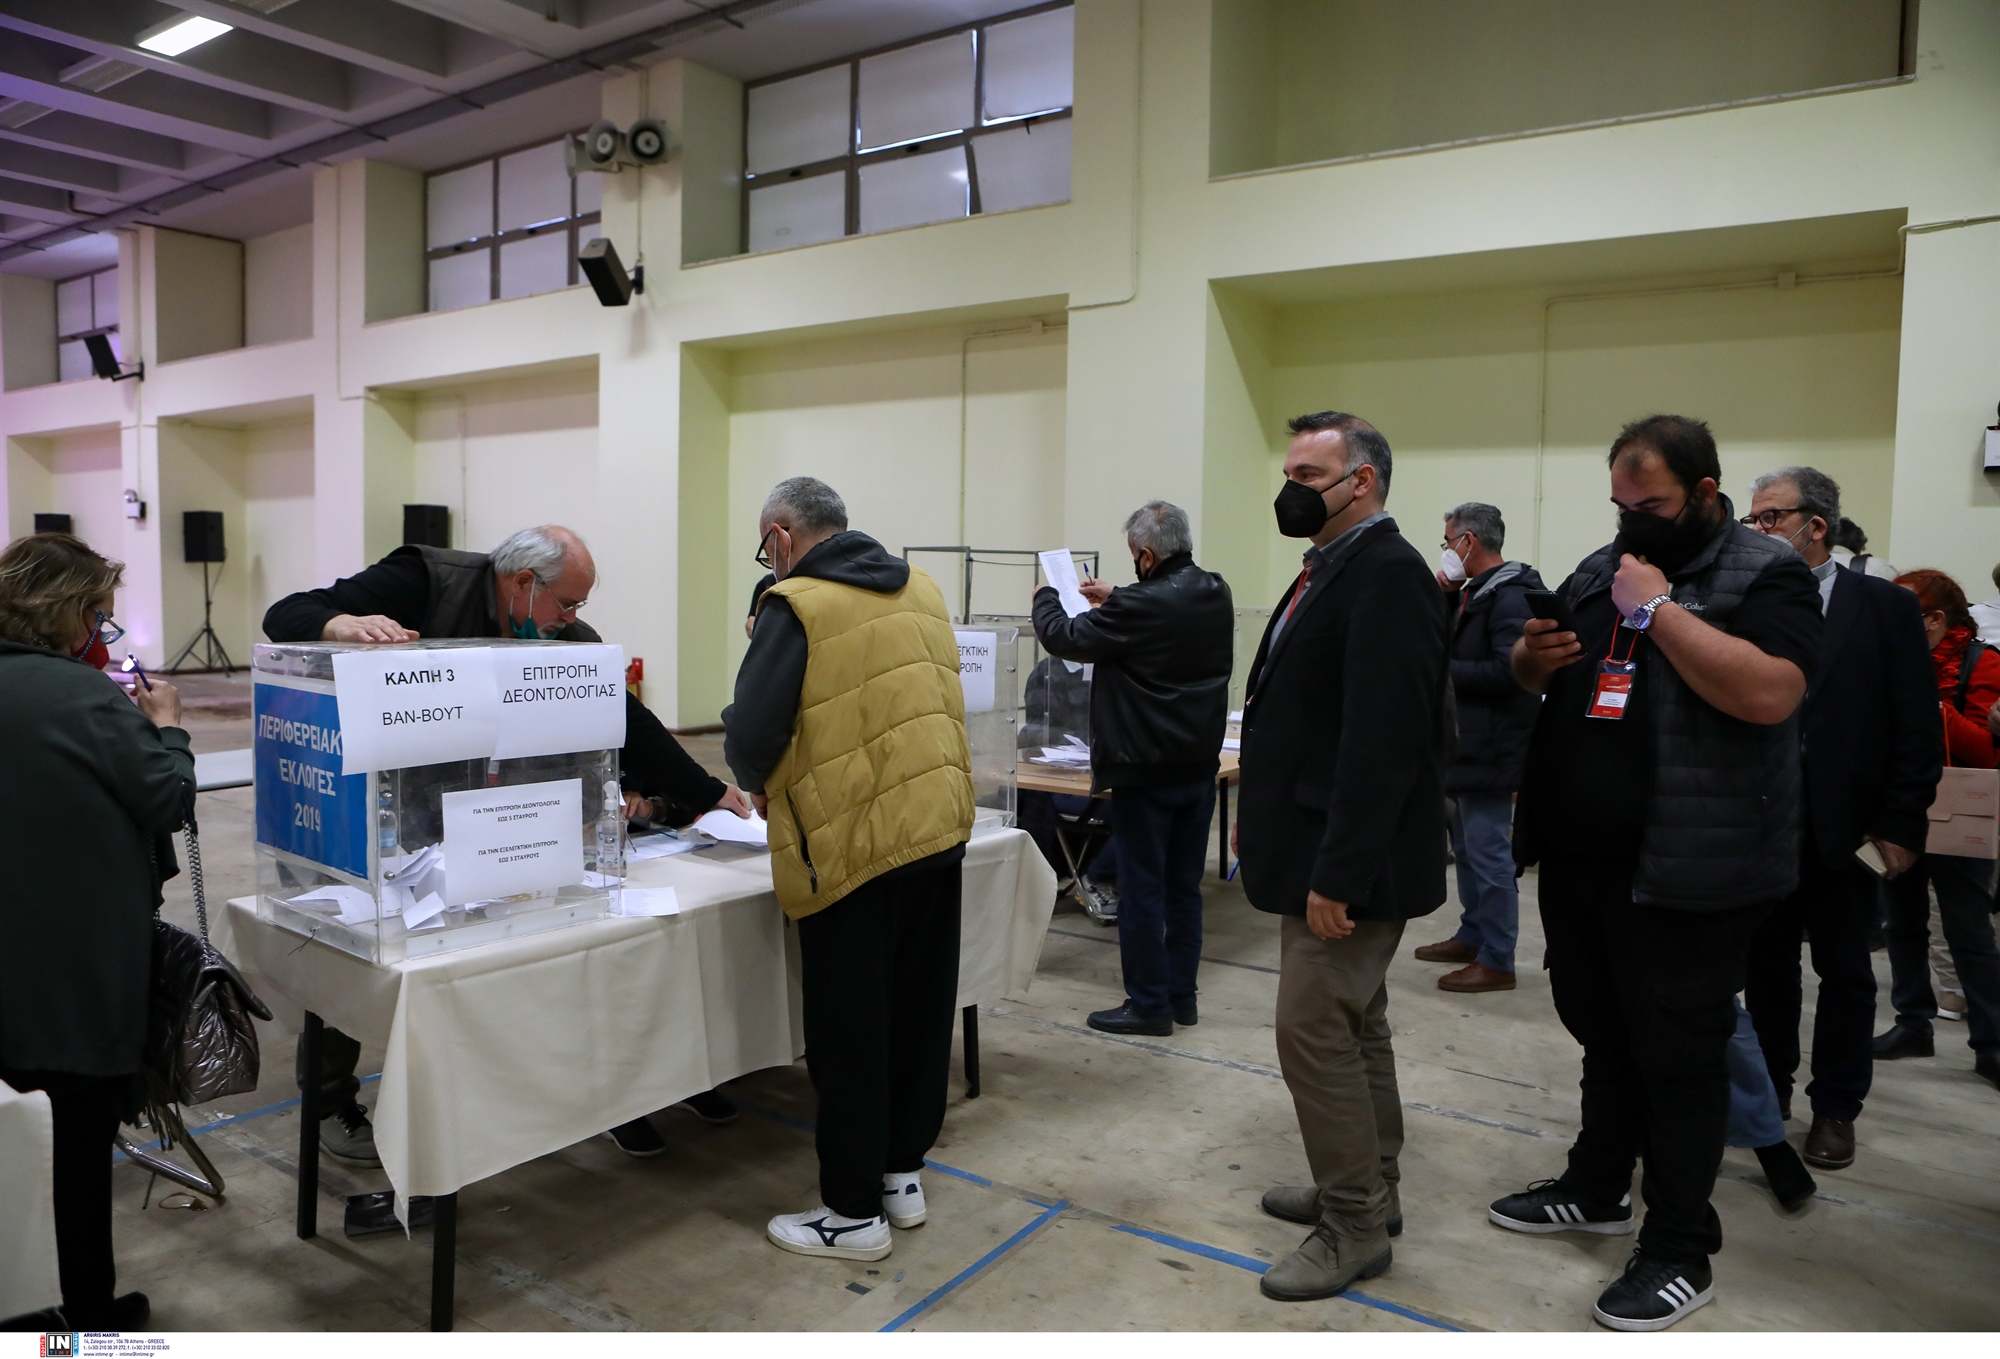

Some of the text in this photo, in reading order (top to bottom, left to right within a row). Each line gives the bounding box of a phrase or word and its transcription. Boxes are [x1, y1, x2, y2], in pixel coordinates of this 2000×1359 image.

[384, 668, 456, 686] ΚΑΛΠΗ 3
[523, 664, 598, 681] ΕΠΙΤΡΟΠΗ
[503, 683, 617, 704] ΔΕΟΝΤΟΛΟΓΙΑΣ
[382, 705, 464, 726] ΒΑΝ-ΒΟΥΤ
[279, 757, 337, 797] ΕΚΛΟΓΕΣ
[495, 804, 522, 812] ΕΠΙΤΡΟΠΗ
[522, 799, 561, 809] ΔΕΟΝΤΟΛΟΓΙΑΣ
[294, 802, 322, 833] 2019
[513, 812, 539, 821] ΣΤΑΥΡΟΥΣ
[499, 844, 532, 853] ΕΞΕΛΕΓΚΤΙΚΗ
[533, 840, 558, 848] ΕΠΙΤΡΟΠΗ
[514, 852, 540, 861] ΣΤΑΥΡΟΥΣ
